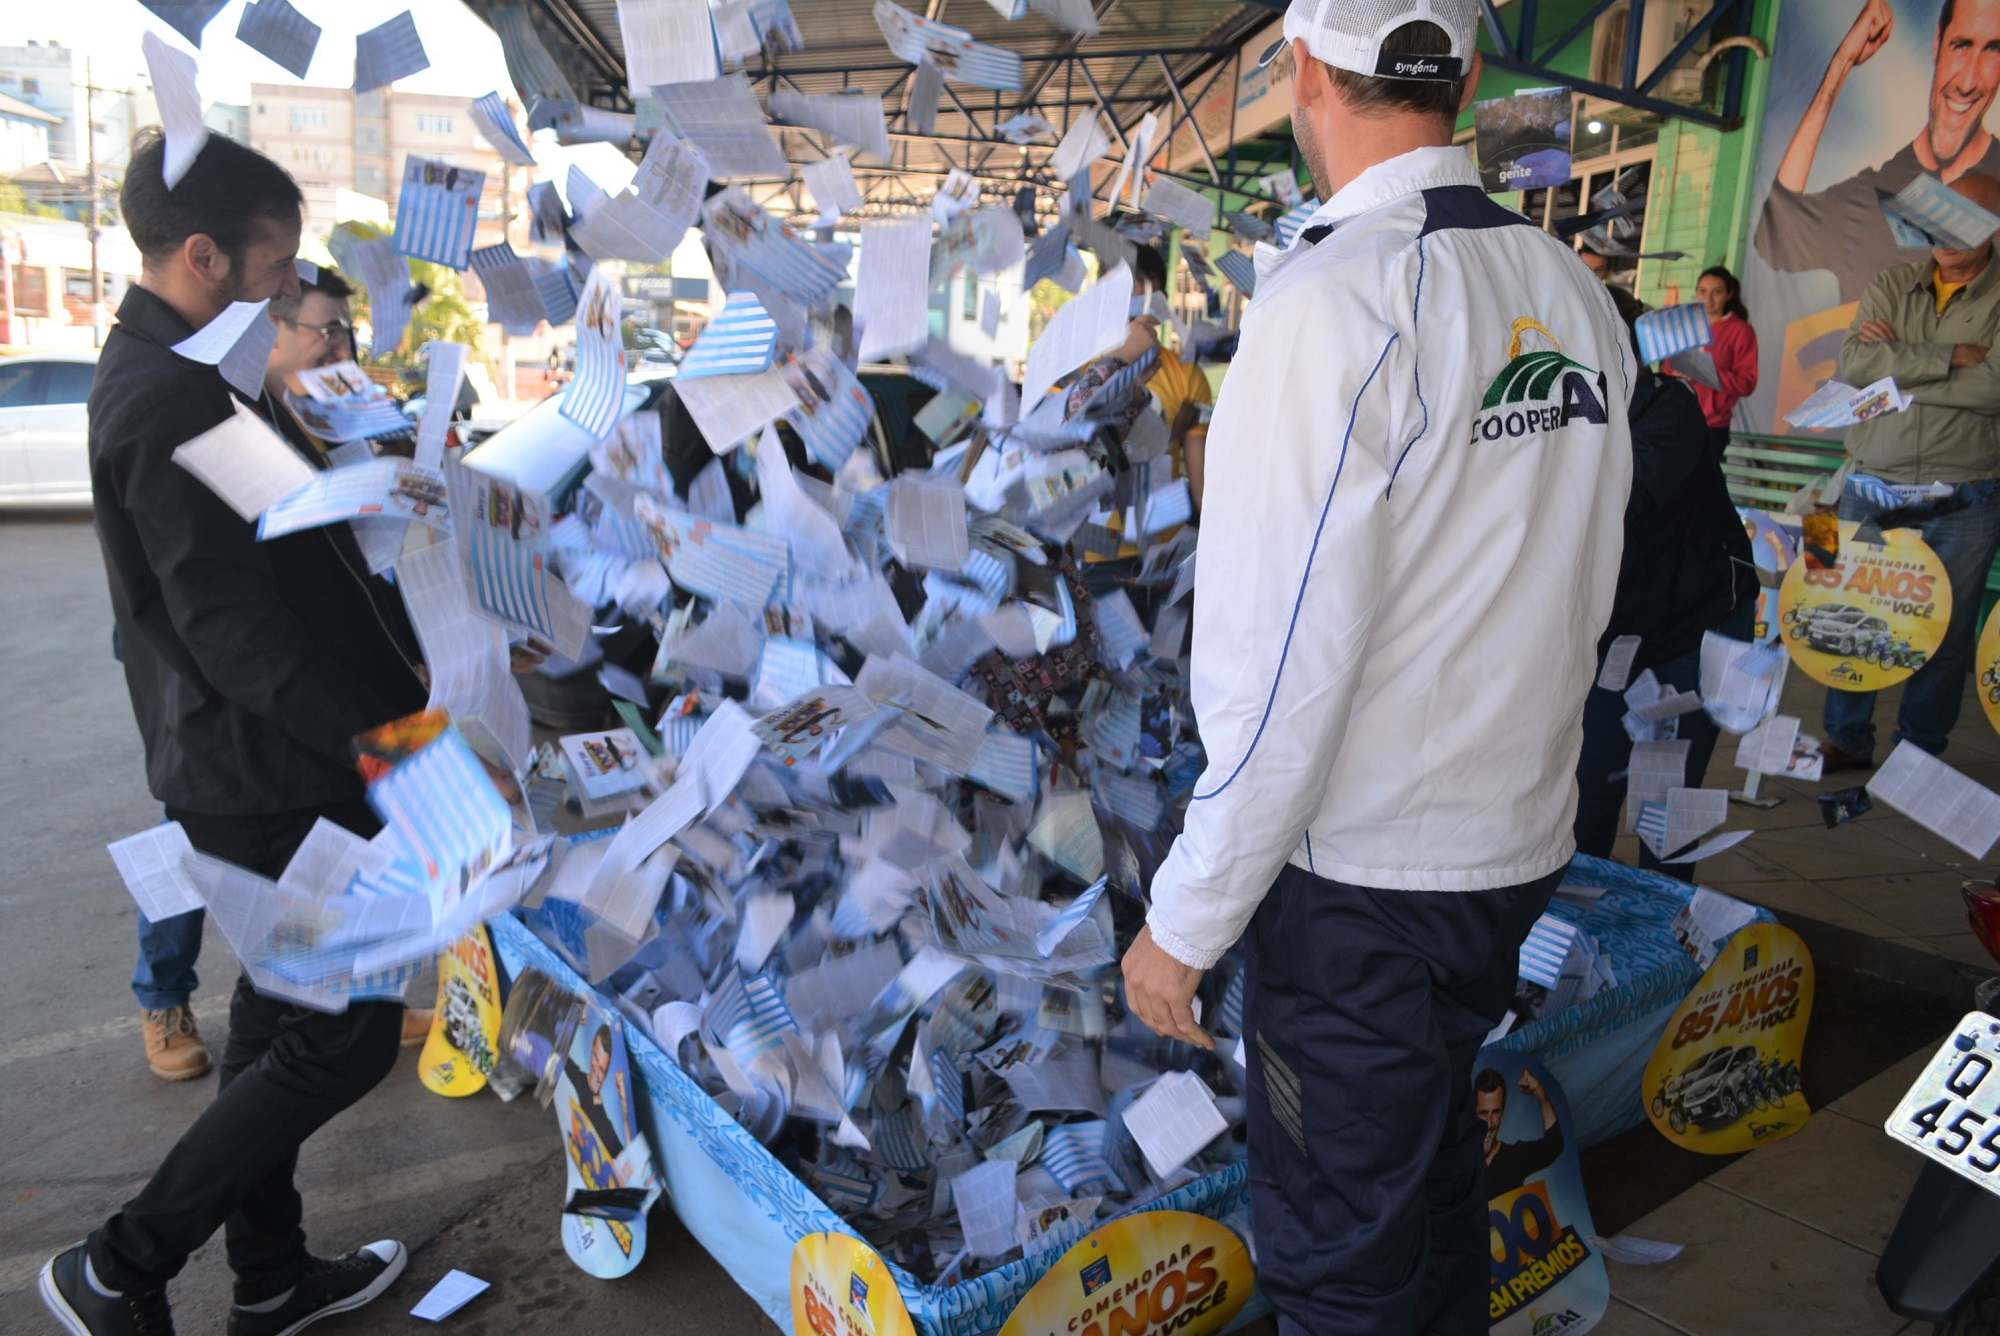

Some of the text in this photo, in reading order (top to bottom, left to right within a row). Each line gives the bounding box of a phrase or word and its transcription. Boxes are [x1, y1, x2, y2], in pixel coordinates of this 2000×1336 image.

[1394, 59, 1438, 76] syngenta
[1498, 166, 1533, 184] gente
[1470, 405, 1560, 445] COOPER
[1853, 555, 1927, 572] COMEMORAR
[1843, 566, 1936, 603] ANOS
[1869, 597, 1936, 619] COM VOCÊ
[1695, 957, 1794, 1006] PARA COMEMORAR
[1671, 965, 1803, 1049] 85 ANOS
[1760, 997, 1801, 1031] VOCÊ
[1945, 1053, 1994, 1102] Q
[1489, 1192, 1553, 1283] 00
[1508, 1233, 1585, 1301] PRÊMIOS
[1067, 1243, 1192, 1333] COMEMORAR
[1161, 1280, 1229, 1336] VOCÊ
[1556, 1308, 1582, 1327] A1
